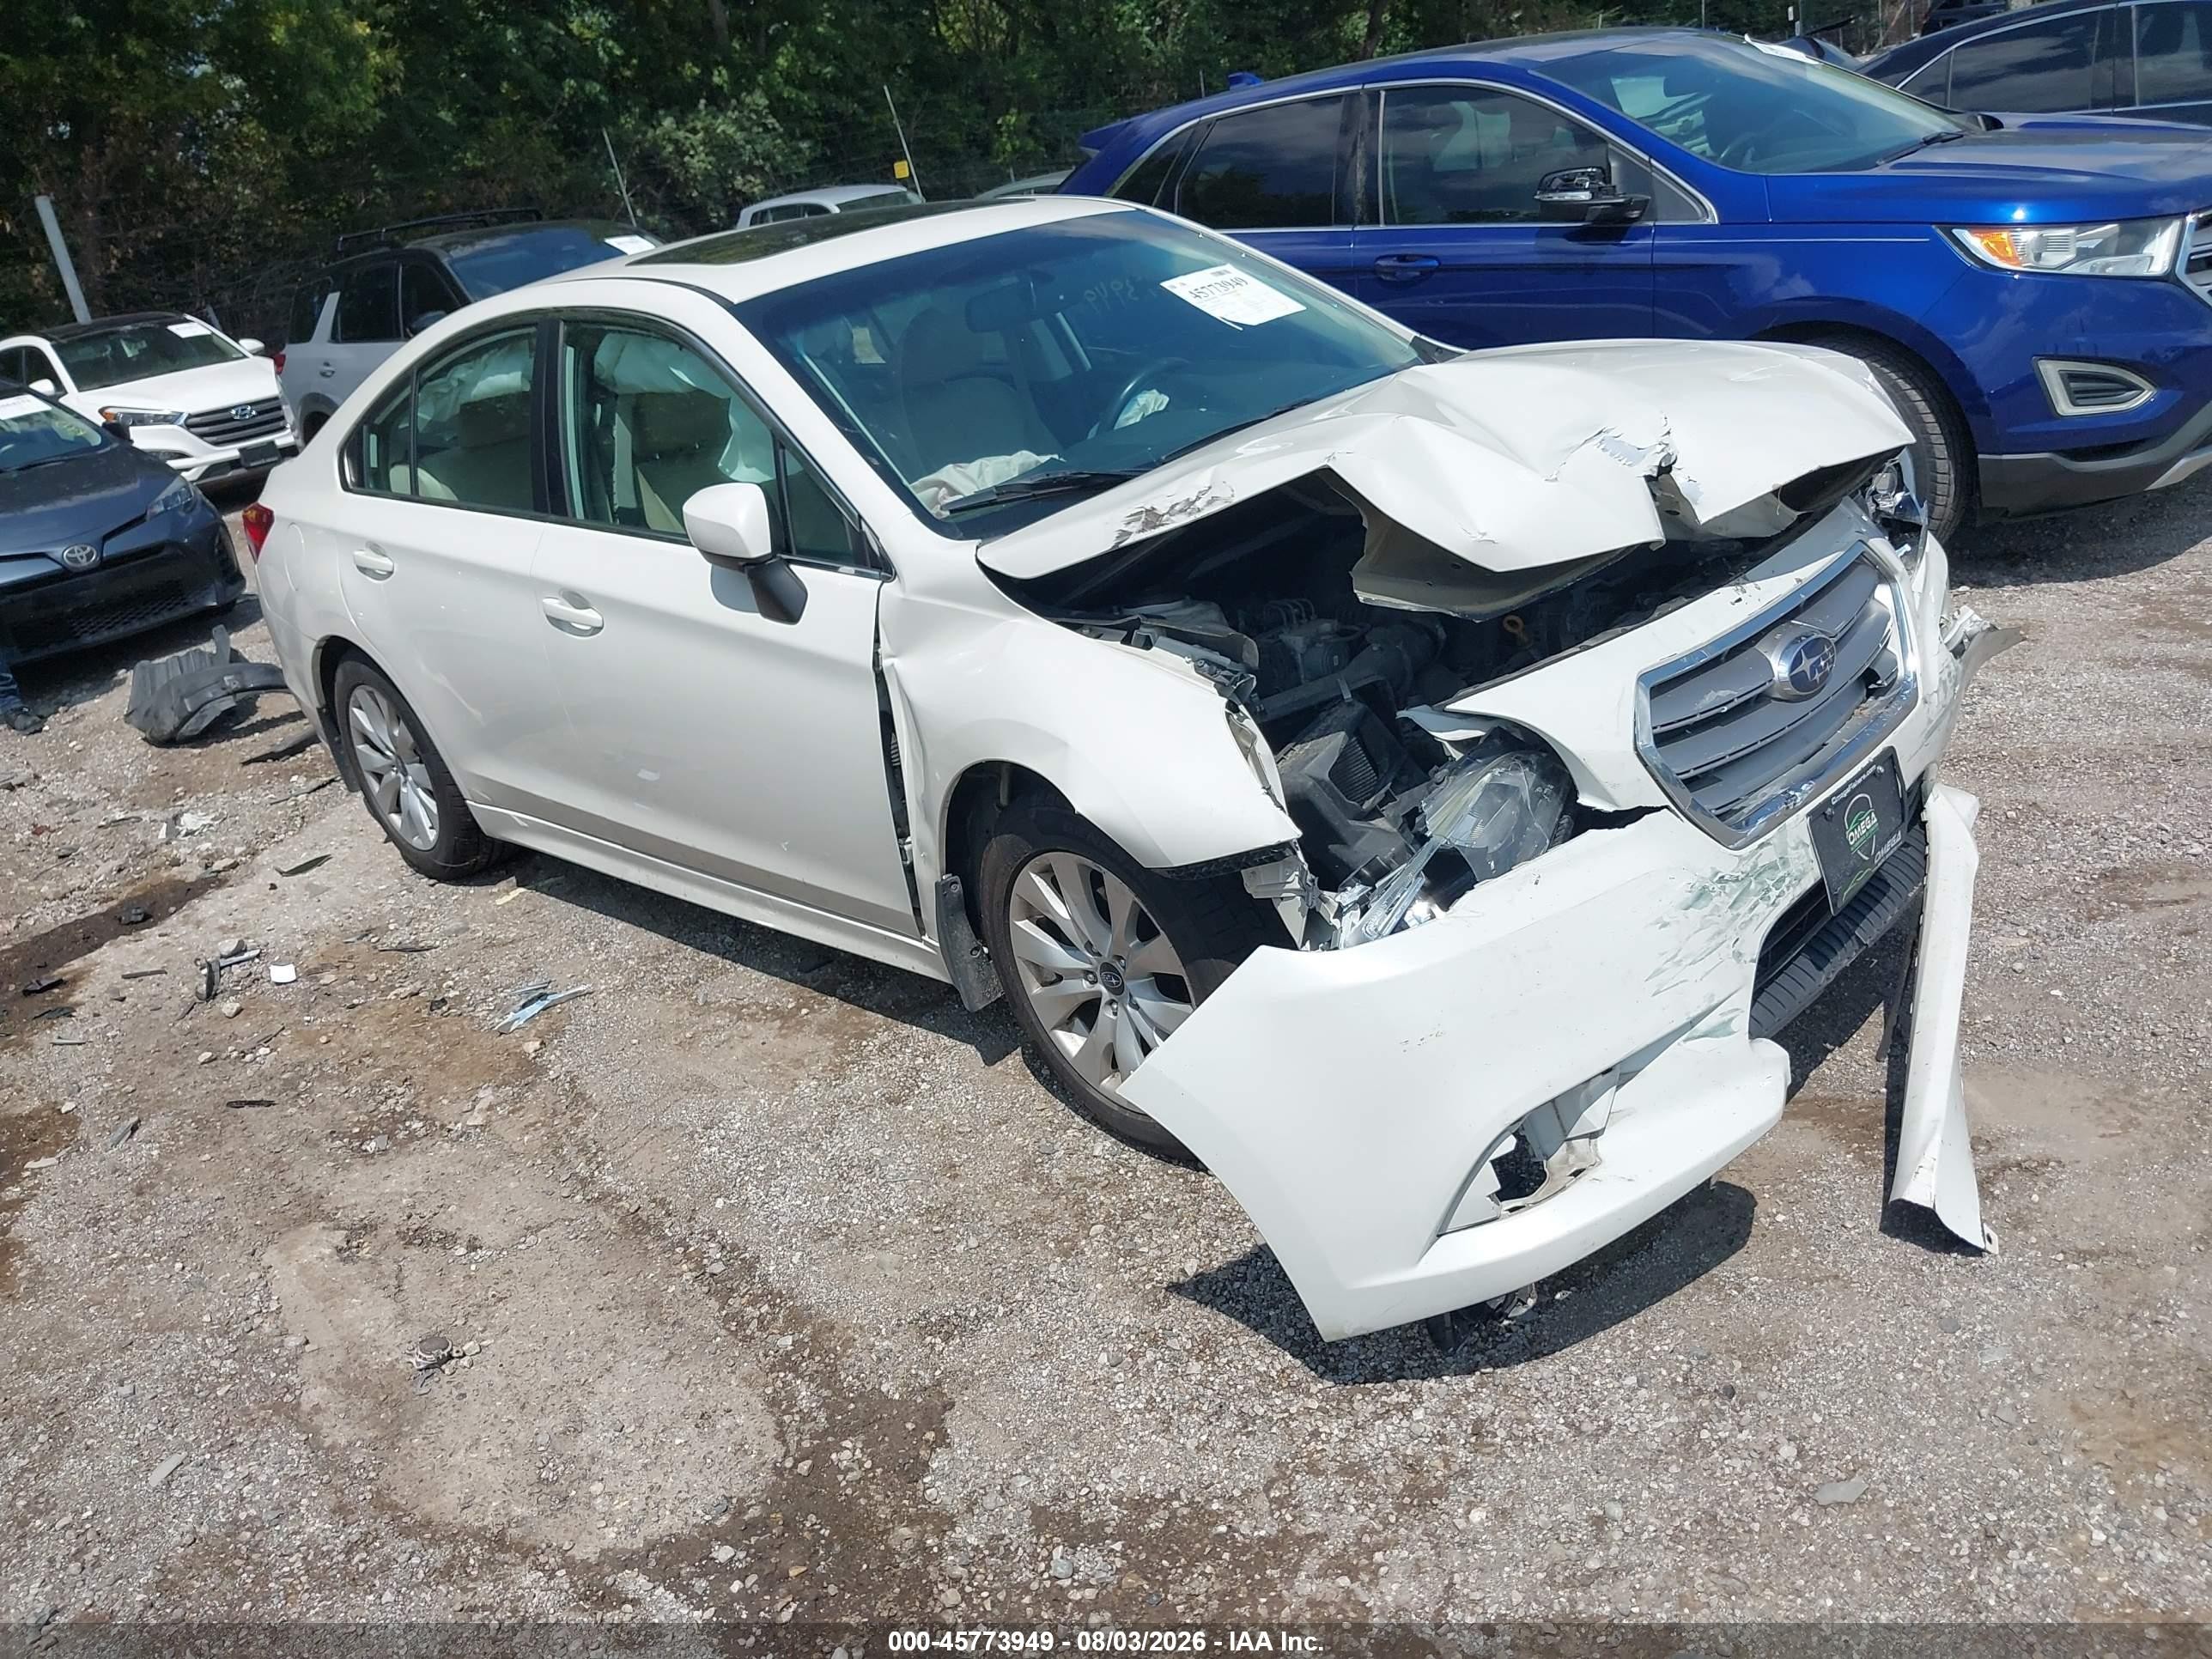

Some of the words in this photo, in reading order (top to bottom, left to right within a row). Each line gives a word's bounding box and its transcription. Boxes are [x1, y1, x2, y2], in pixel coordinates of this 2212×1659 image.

[1188, 276, 1249, 299] 45773949
[1847, 811, 1878, 844] OMEGA
[1874, 830, 1902, 864] OMEGA
